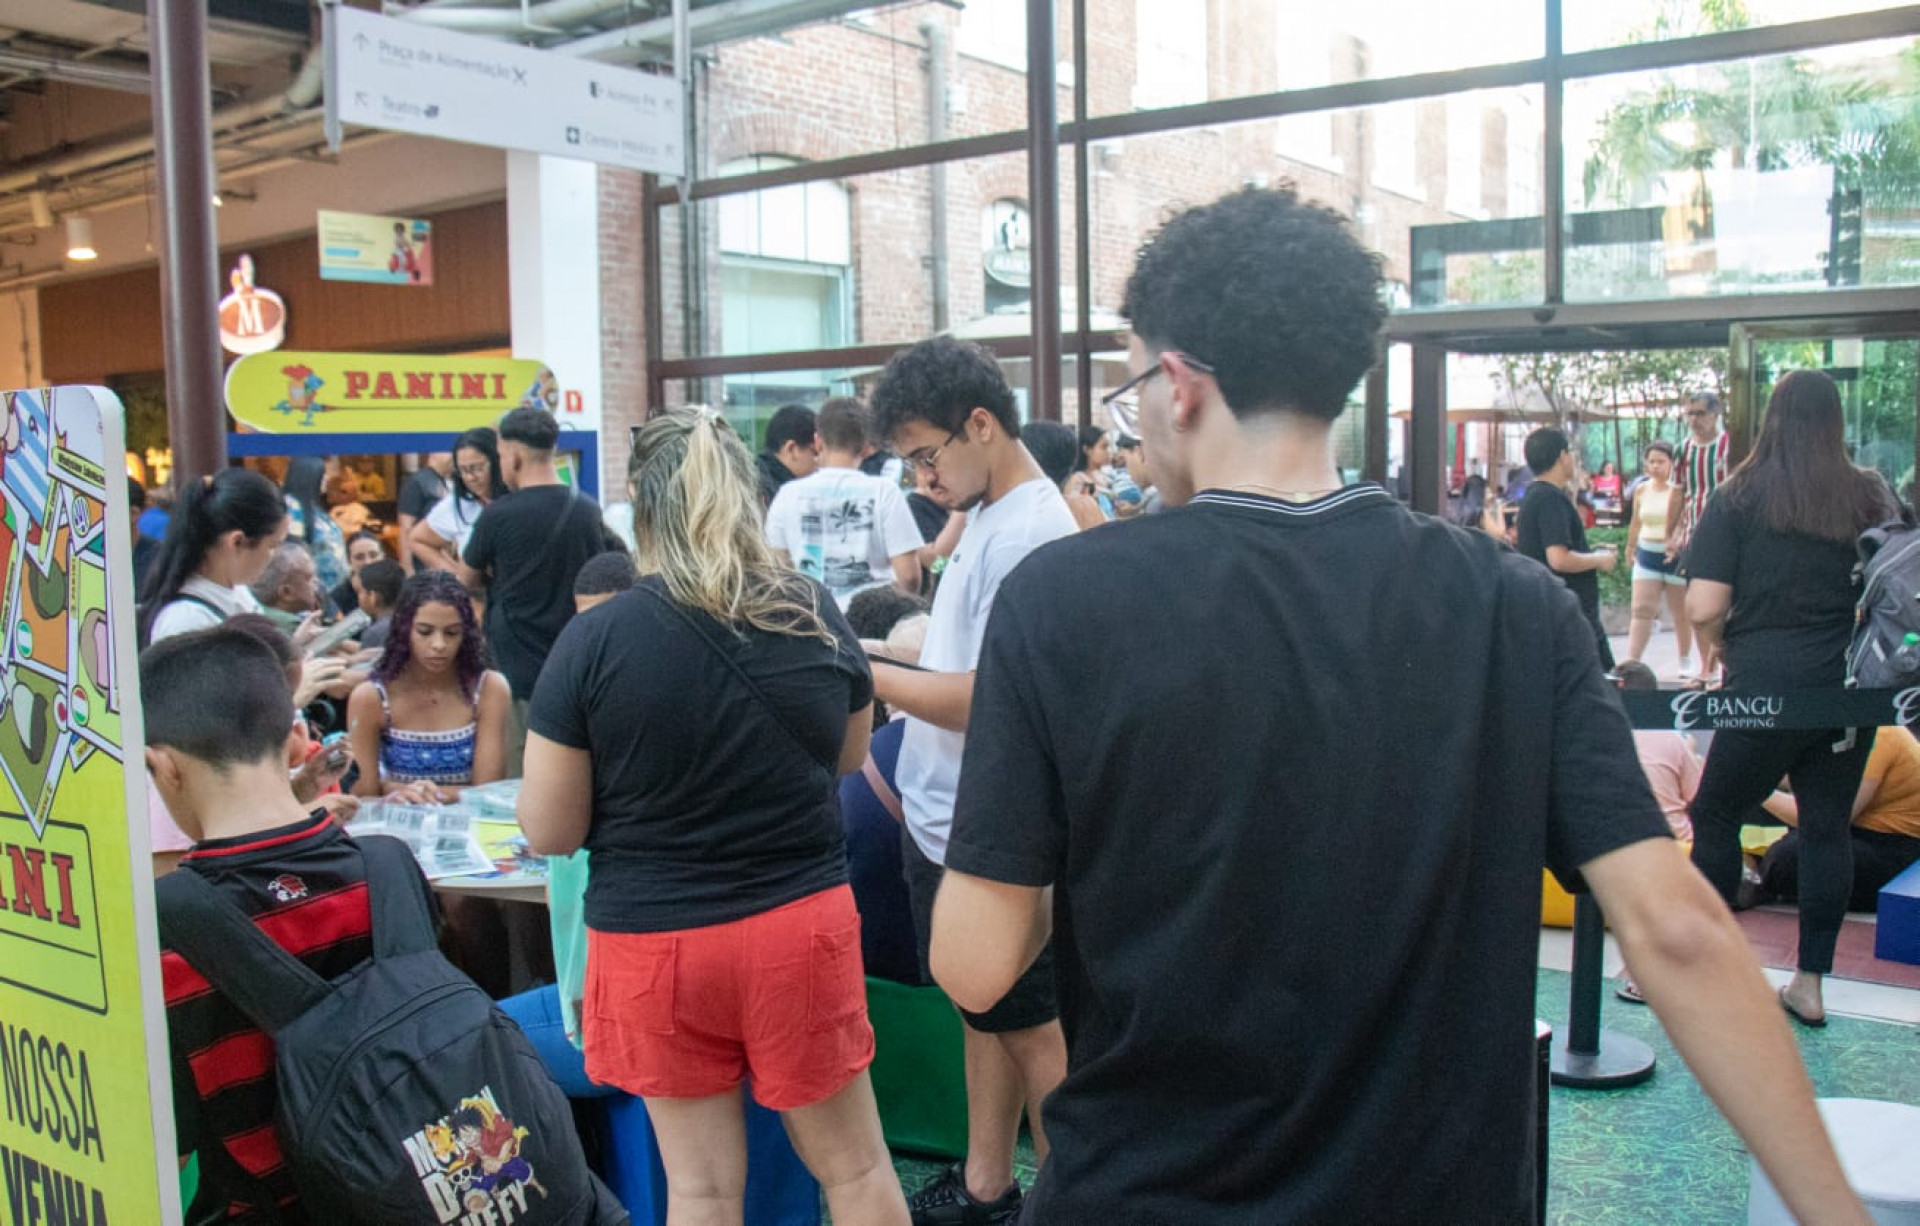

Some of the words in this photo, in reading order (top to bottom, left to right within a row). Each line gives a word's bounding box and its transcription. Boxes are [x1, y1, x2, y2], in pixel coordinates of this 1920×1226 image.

[237, 299, 264, 335] M
[343, 370, 507, 400] PANINI
[1706, 696, 1783, 715] BANGU
[1713, 718, 1775, 728] SHOPPING
[0, 842, 81, 928] NI
[0, 1020, 104, 1163] NOSSA
